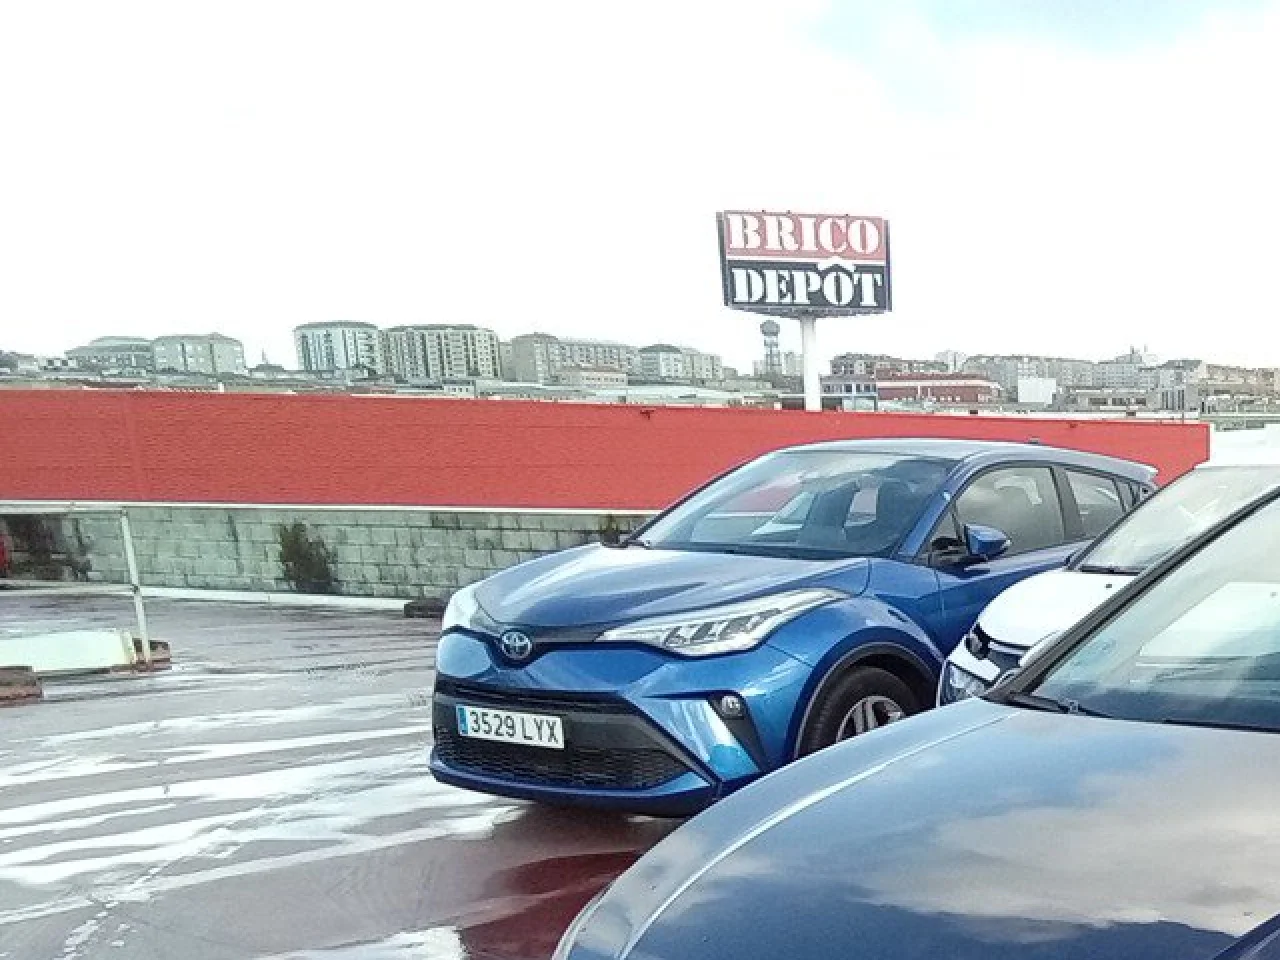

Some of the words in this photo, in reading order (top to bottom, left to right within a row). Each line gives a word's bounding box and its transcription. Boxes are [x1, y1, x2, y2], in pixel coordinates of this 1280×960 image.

[727, 214, 880, 254] BRICO
[731, 257, 883, 306] DEPÔT
[469, 711, 516, 738] 3529
[520, 717, 559, 744] LYX
